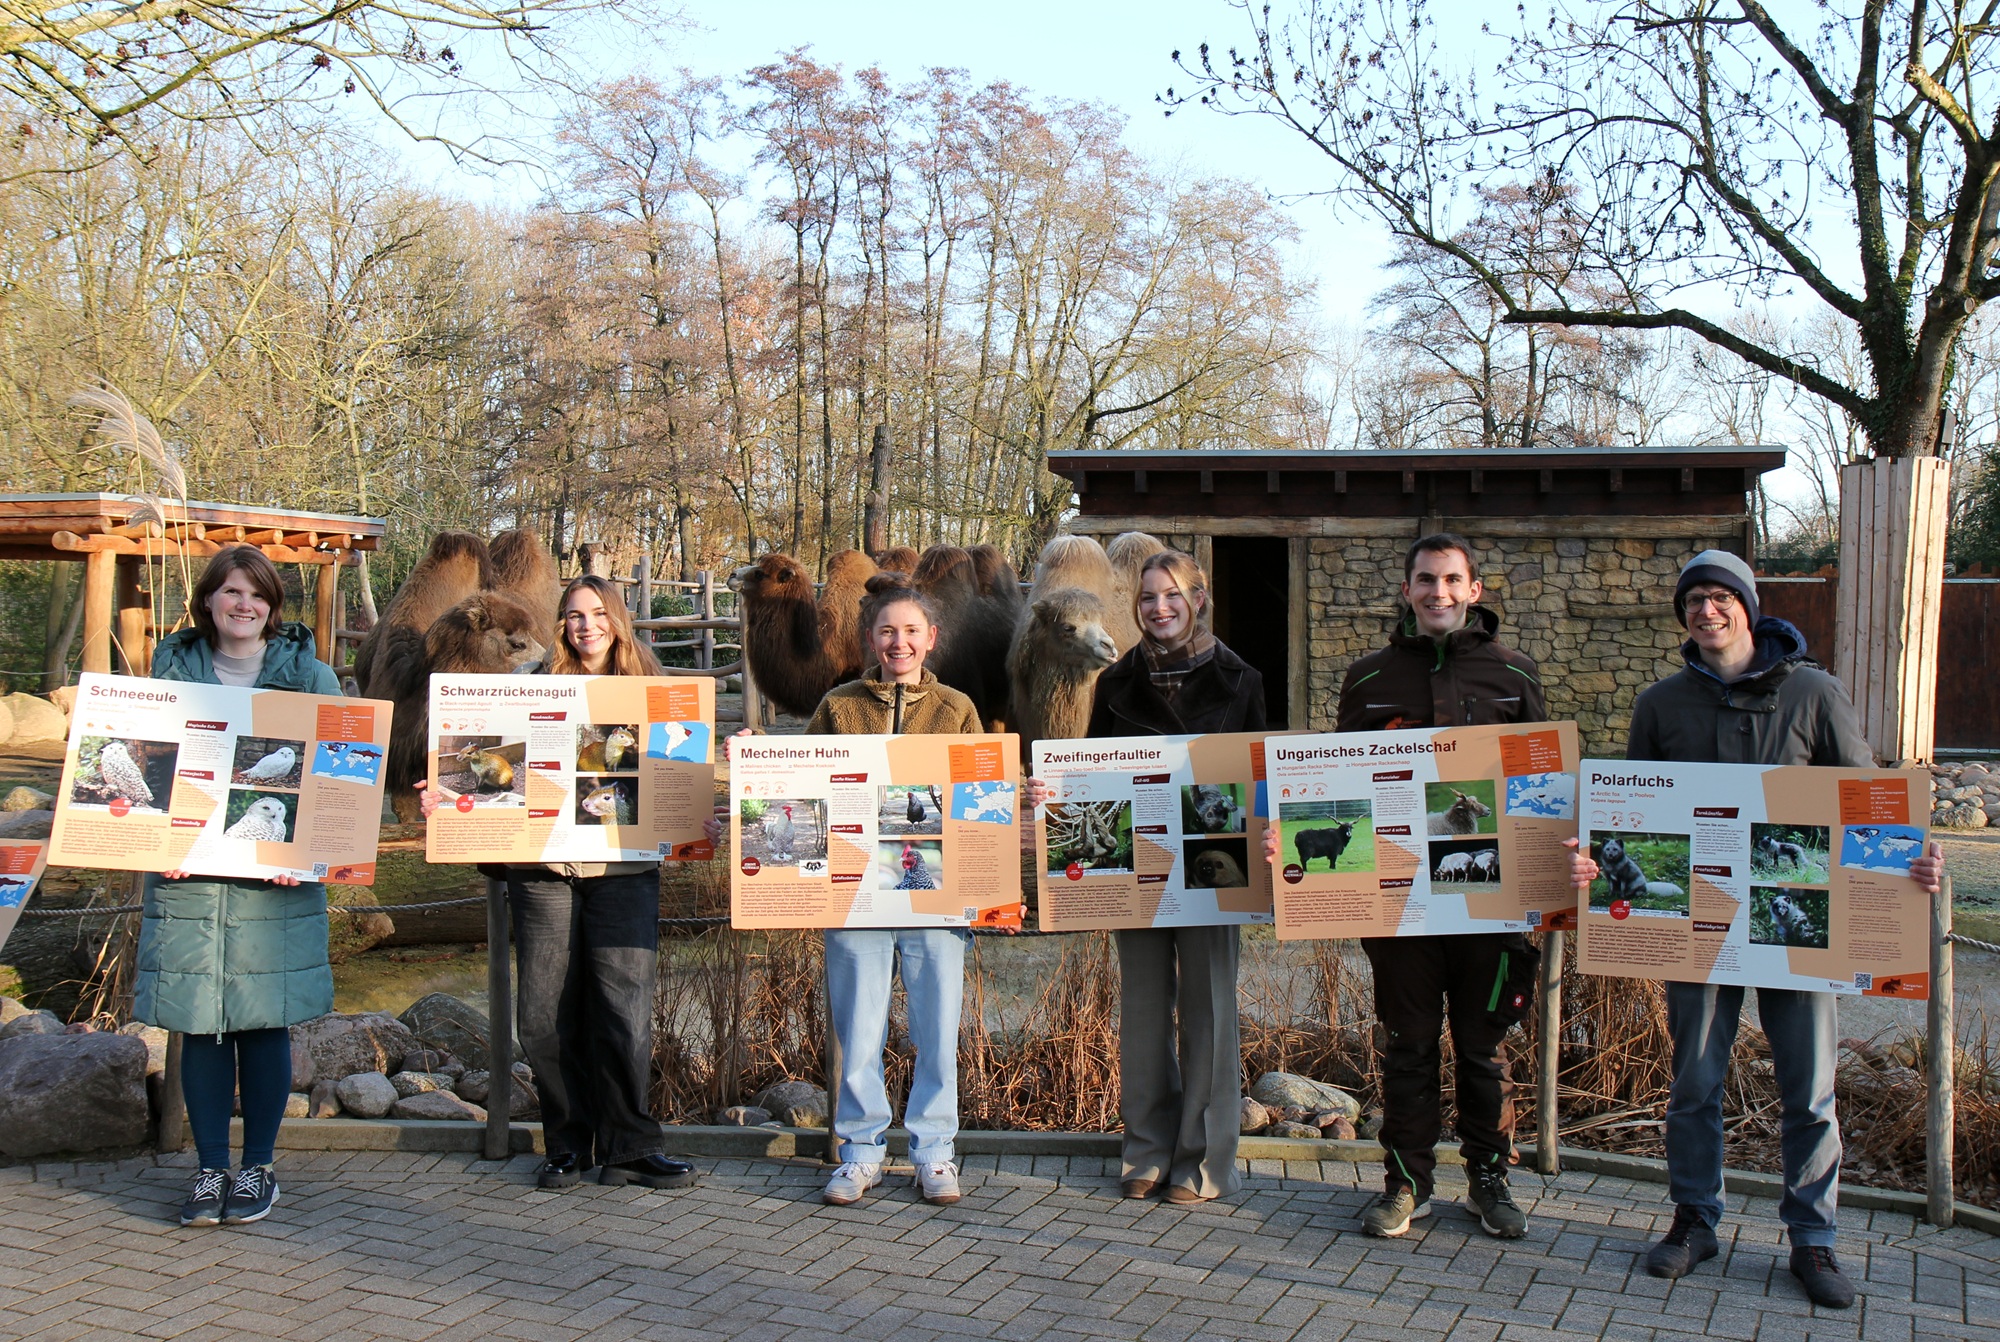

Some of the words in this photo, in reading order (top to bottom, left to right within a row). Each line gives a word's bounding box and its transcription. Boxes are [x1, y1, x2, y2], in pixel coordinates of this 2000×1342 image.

[90, 685, 178, 703] Schneeeule
[440, 685, 577, 699] Schwarzrückenaguti
[740, 747, 811, 759] Mechelner
[815, 747, 850, 759] Huhn
[1043, 749, 1162, 764] Zweifingerfaultier
[1276, 746, 1365, 762] Ungarisches
[1368, 741, 1457, 756] Zackelschaf
[1591, 773, 1675, 788] Polarfuchs
[1693, 923, 1726, 931] Wohnlabyrinth
